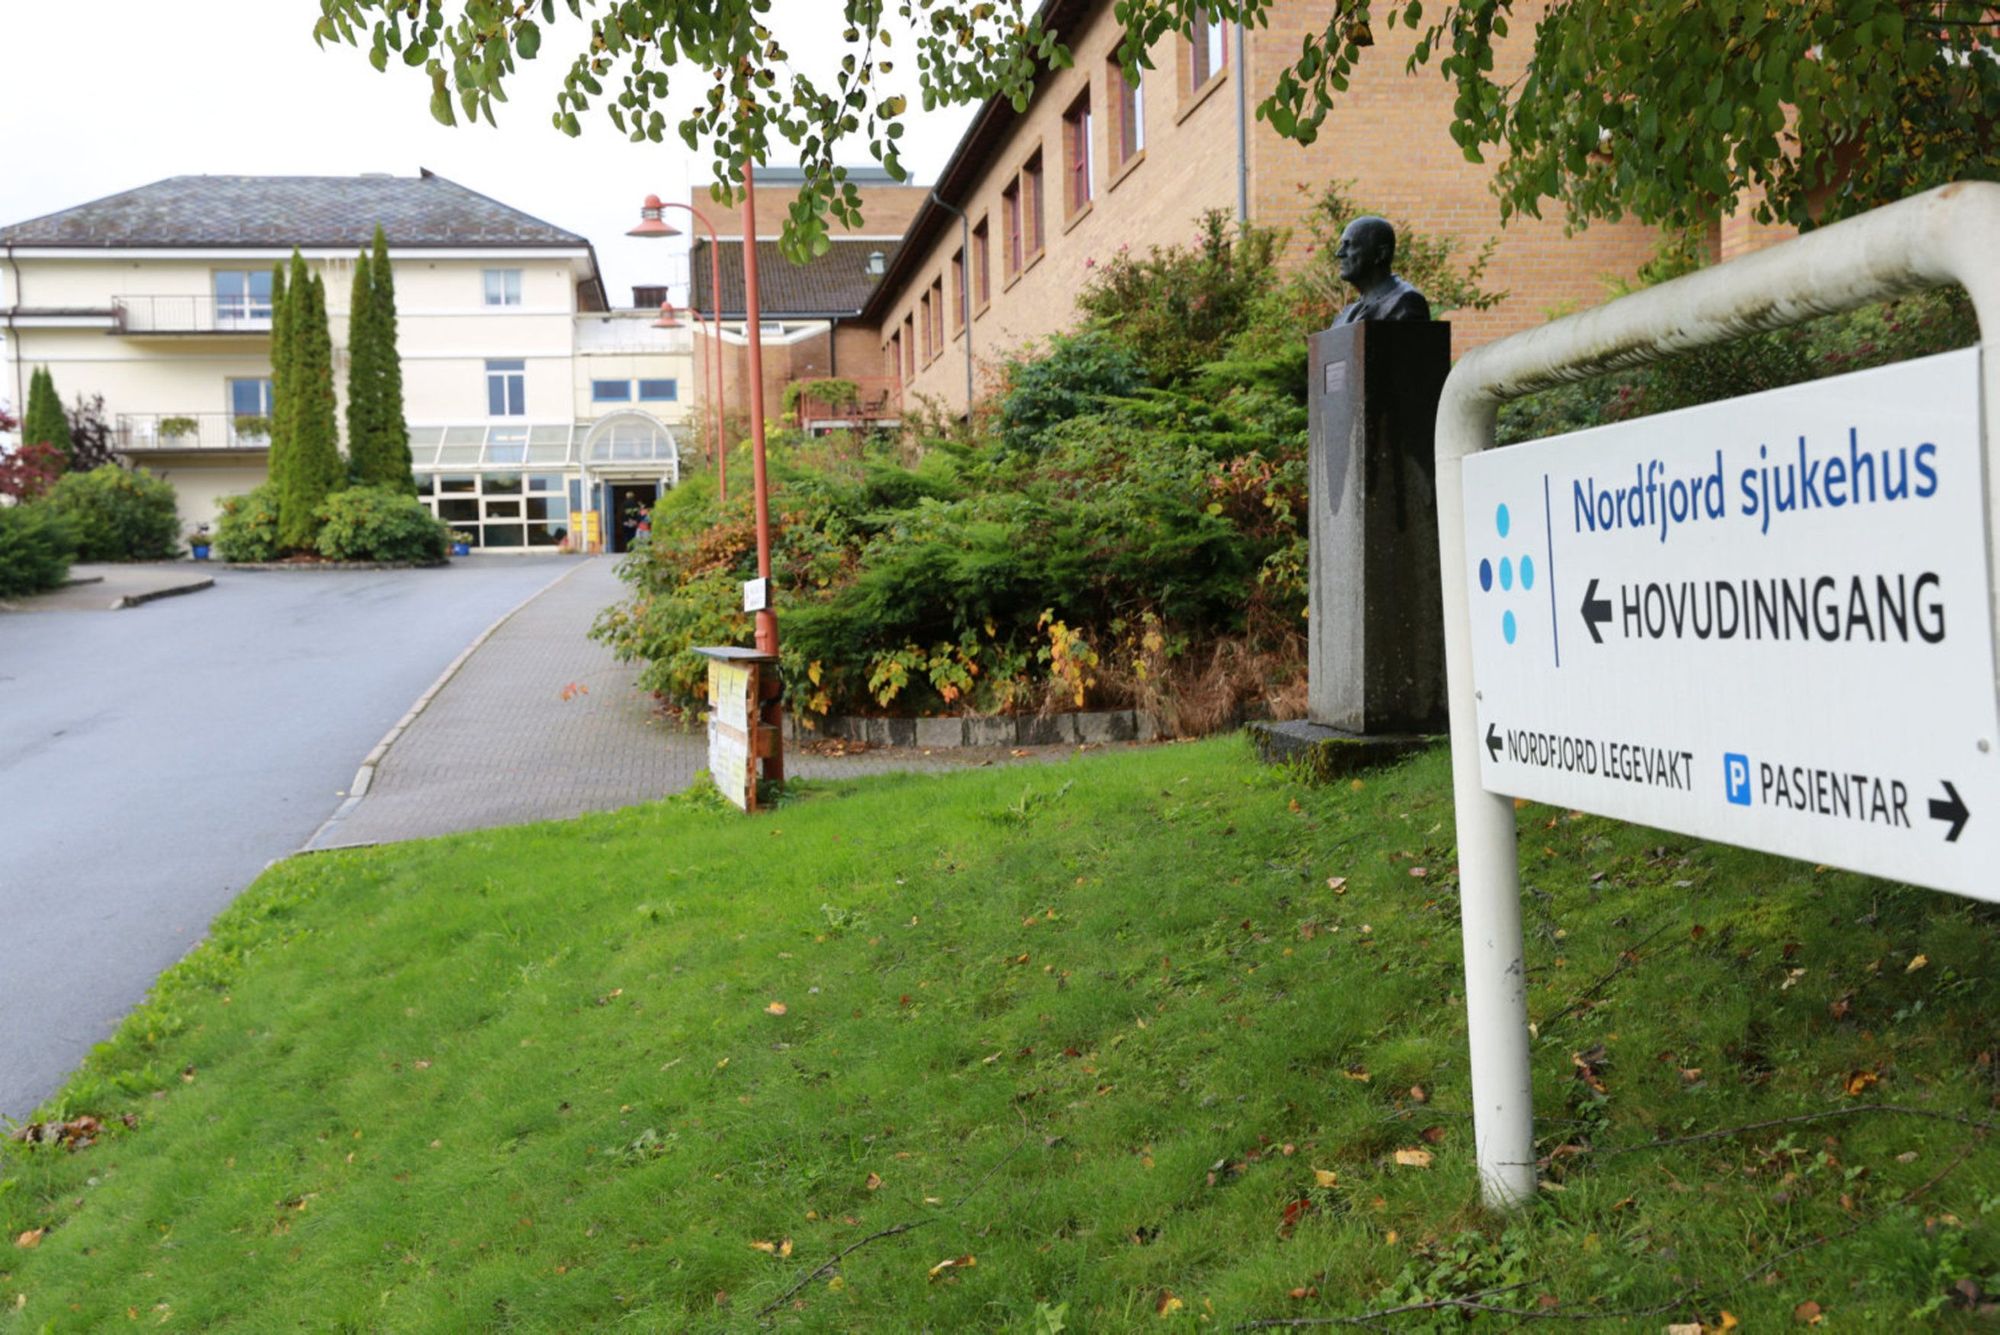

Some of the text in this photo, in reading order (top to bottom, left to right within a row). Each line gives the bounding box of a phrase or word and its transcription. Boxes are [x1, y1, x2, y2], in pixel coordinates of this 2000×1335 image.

[1573, 427, 1939, 543] Nordfjord sjukehus
[1621, 572, 1946, 644] HOVUDINNGANG
[1507, 729, 1693, 791] NORDFJORD LEGEVAKT
[1760, 762, 1912, 829] PASIENTAR
